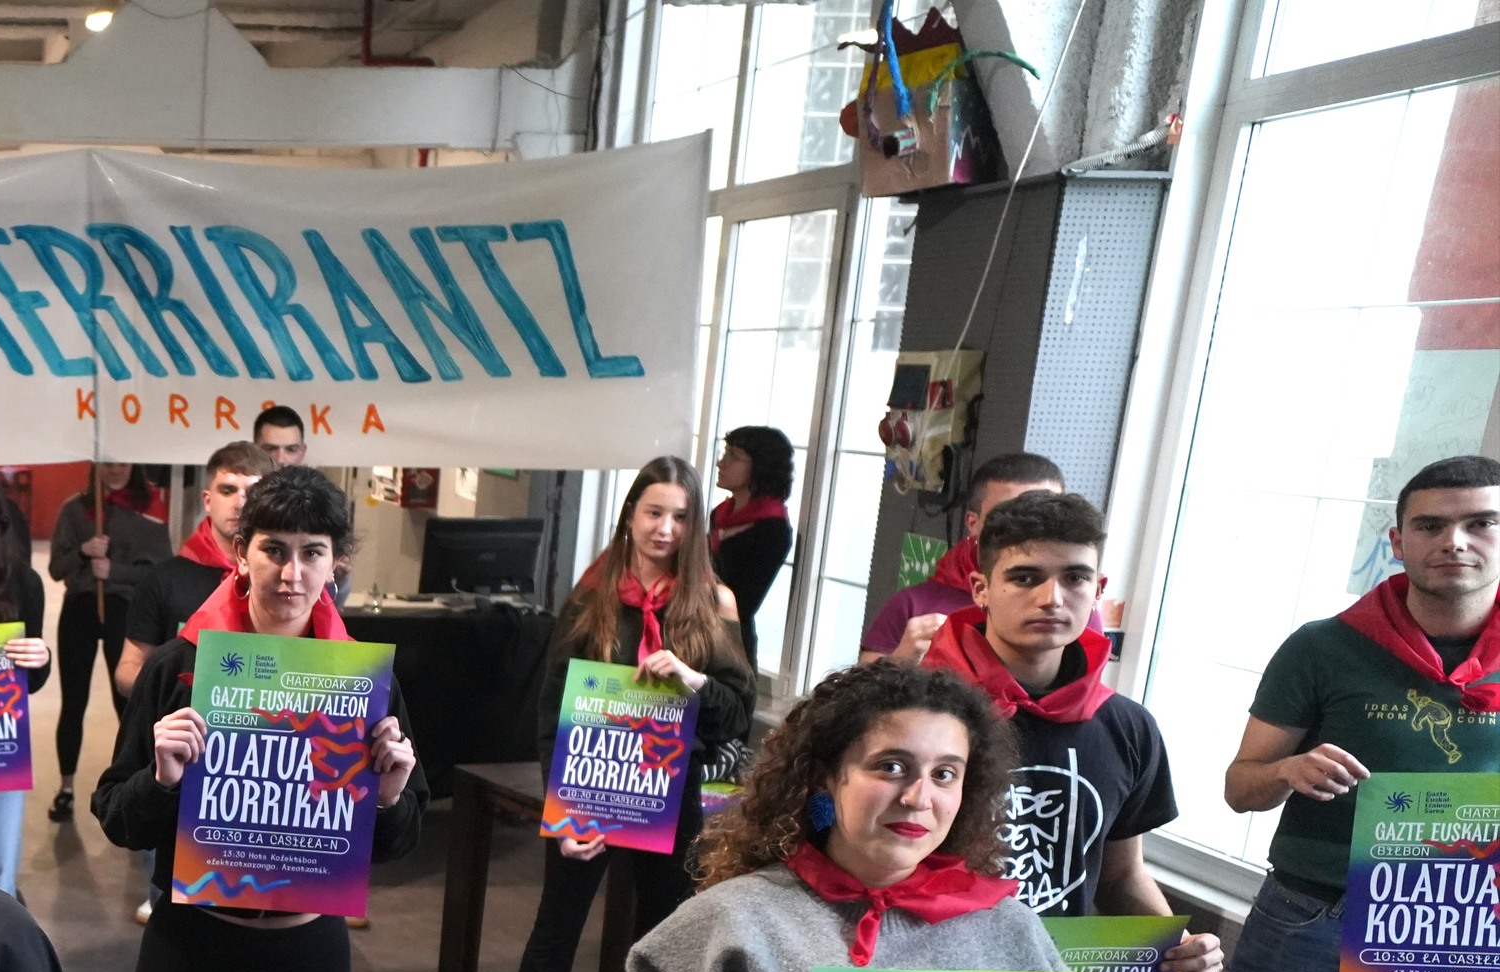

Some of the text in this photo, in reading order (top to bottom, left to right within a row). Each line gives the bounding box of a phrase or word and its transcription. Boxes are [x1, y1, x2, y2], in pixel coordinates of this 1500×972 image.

[76, 388, 385, 435] KORRKA
[286, 675, 370, 691] MARTXOAK 29
[211, 686, 369, 718] GAZTE EUSKALTZALEON
[575, 696, 684, 723] GAZTE EUSKALTZALEON
[1365, 703, 1408, 711] IDEAS
[212, 713, 258, 726] BILBON
[1367, 712, 1407, 720] FROM
[569, 725, 644, 762] OLATUA
[204, 731, 315, 781] OLATUA
[563, 755, 670, 796] KORRIKAN
[199, 776, 355, 831] KORRIKAN
[205, 829, 242, 842] 10:30
[248, 833, 264, 844] LA
[1375, 822, 1425, 841] GAZTE
[223, 850, 246, 858] 13:30
[248, 852, 267, 860] Hots
[1377, 846, 1430, 856] BILBON
[1369, 862, 1499, 904] OLATUA
[1365, 903, 1500, 947] KORRIK
[1064, 950, 1153, 961] MARTXOAK 29
[1373, 951, 1415, 962] 10:30
[1423, 953, 1441, 963] LA
